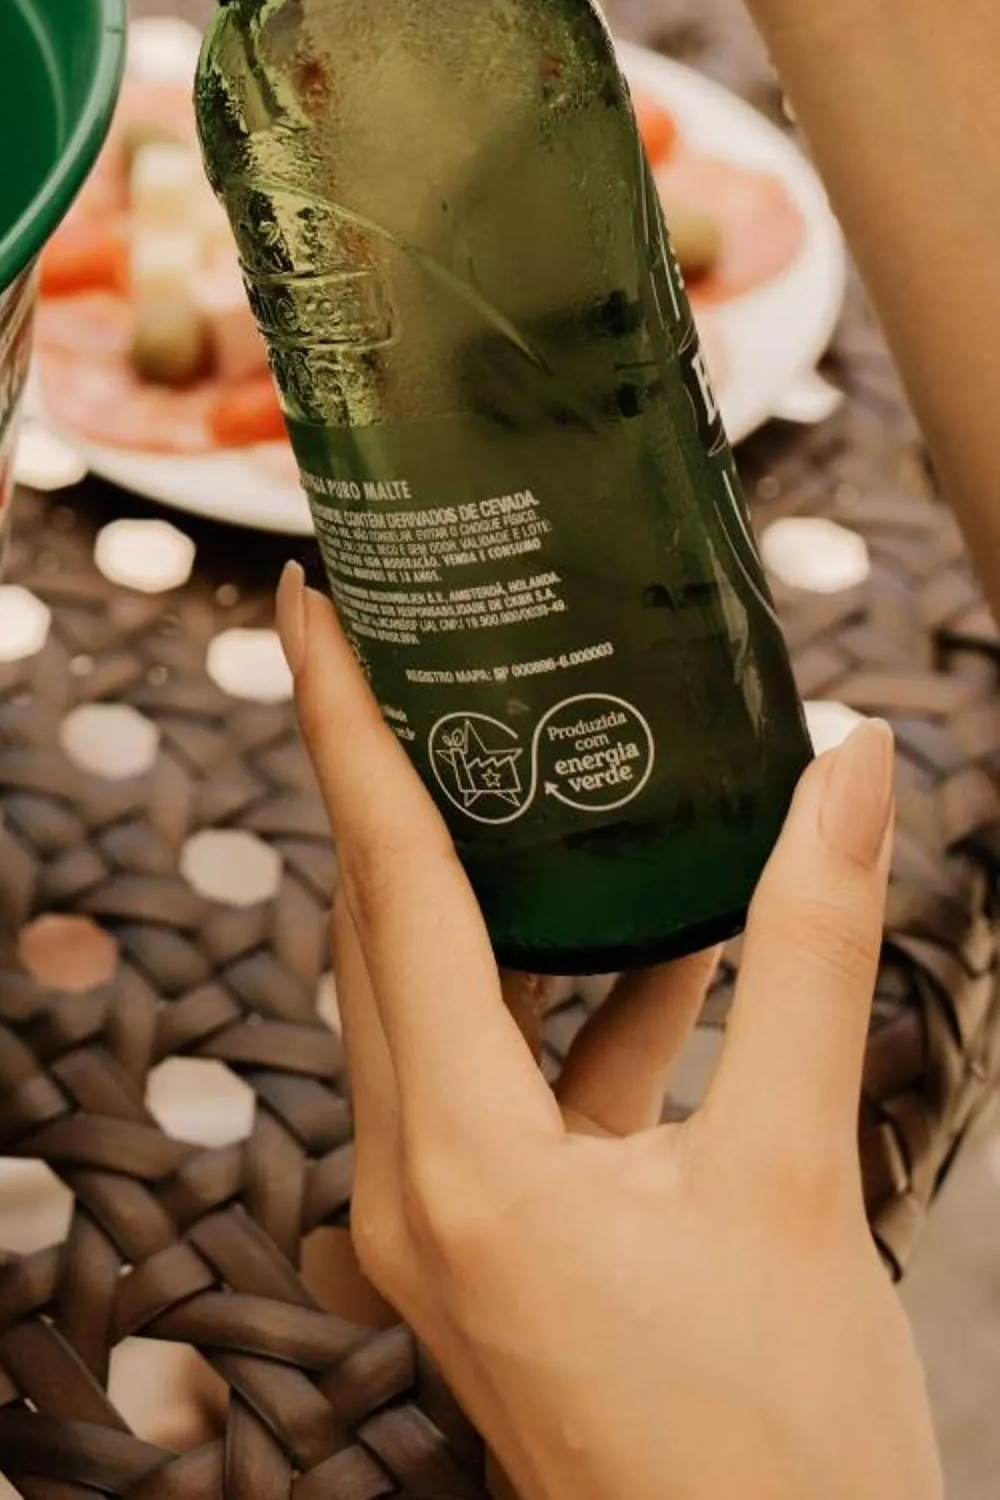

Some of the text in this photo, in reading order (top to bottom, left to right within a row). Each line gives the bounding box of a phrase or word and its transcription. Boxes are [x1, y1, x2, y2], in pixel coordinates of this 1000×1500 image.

[325, 478, 361, 501] PURO
[362, 479, 412, 501] MALTE
[385, 506, 459, 529] DERIVADOS
[458, 501, 480, 522] DE
[459, 530, 511, 551] VALIDADE
[511, 525, 522, 540] E
[487, 535, 542, 561] CONSUMO
[547, 711, 628, 741] Produzida
[575, 733, 610, 752] com
[554, 741, 640, 776] energia
[567, 762, 634, 793] verde
